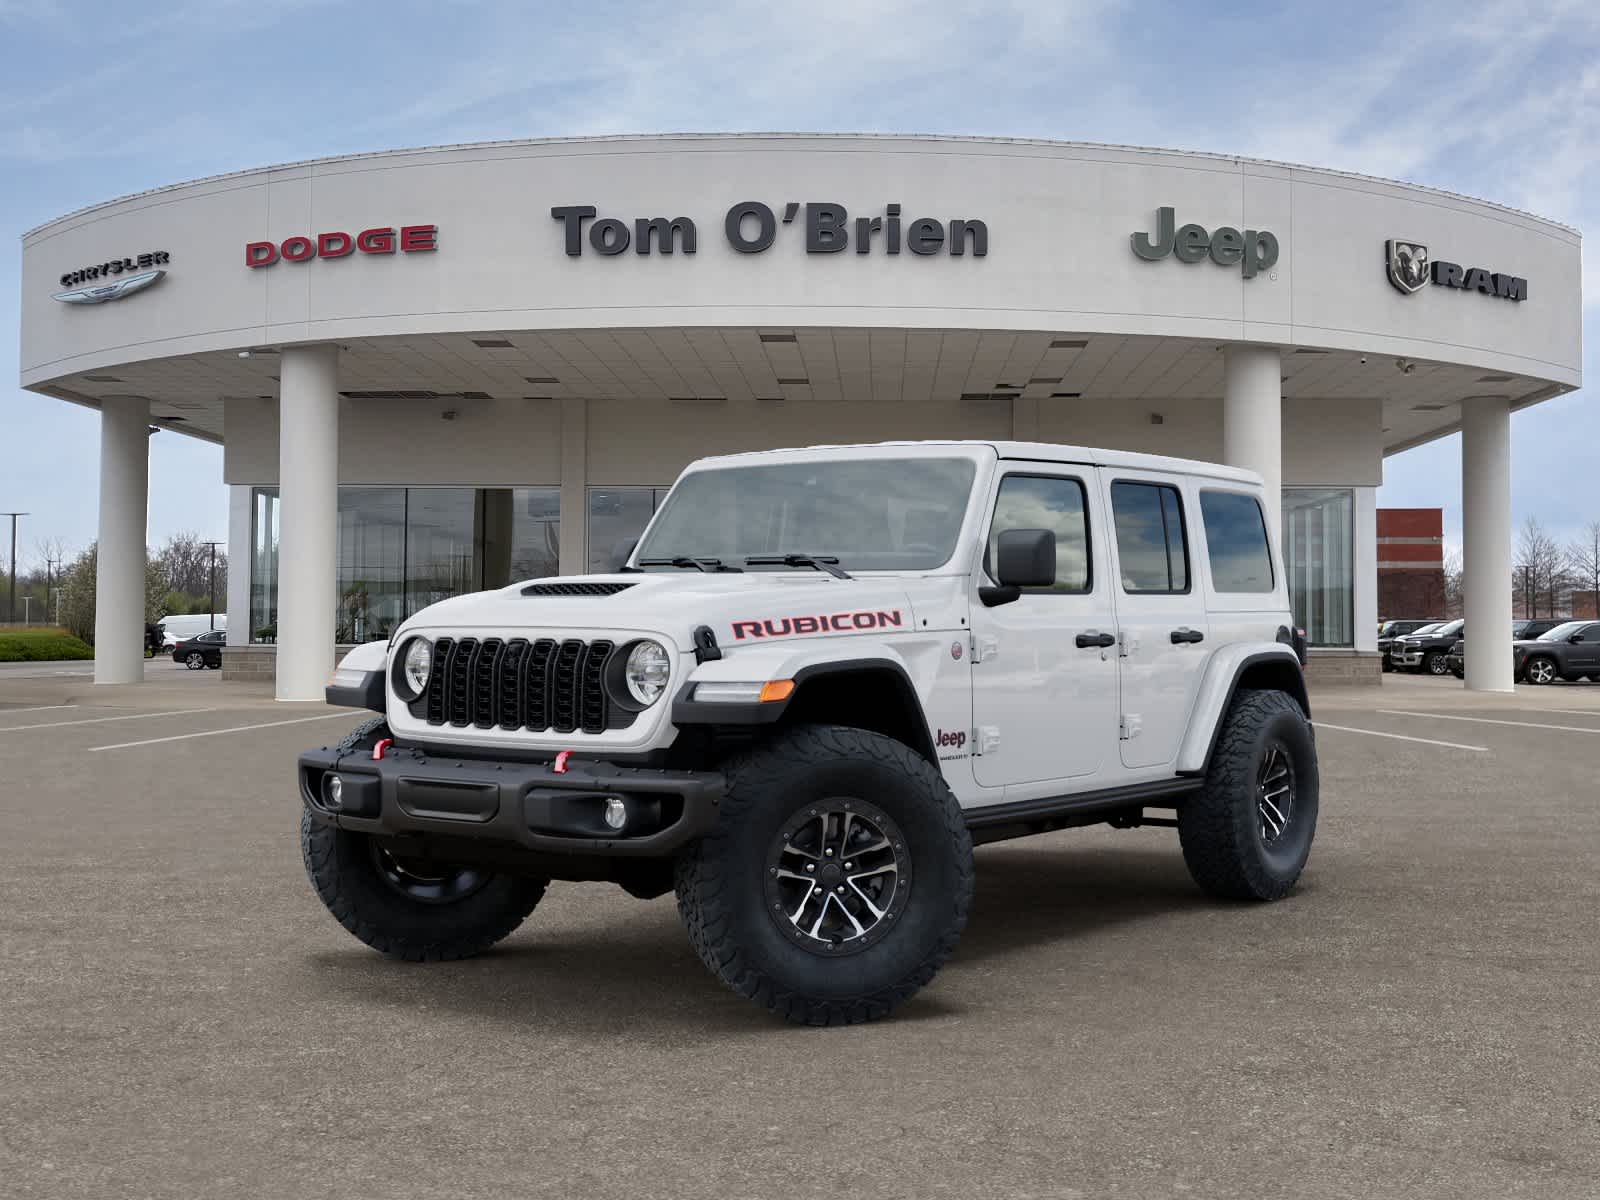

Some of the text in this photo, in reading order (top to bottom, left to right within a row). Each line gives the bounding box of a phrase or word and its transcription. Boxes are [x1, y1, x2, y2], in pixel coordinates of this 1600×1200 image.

[245, 225, 438, 269] DODGE
[551, 201, 988, 256] Tom O'Brien
[1131, 207, 1279, 279] Jeep
[60, 250, 170, 286] CHRYSLER
[1431, 260, 1528, 301] RAM
[731, 610, 902, 640] RUBICON
[935, 728, 966, 749] Jeep
